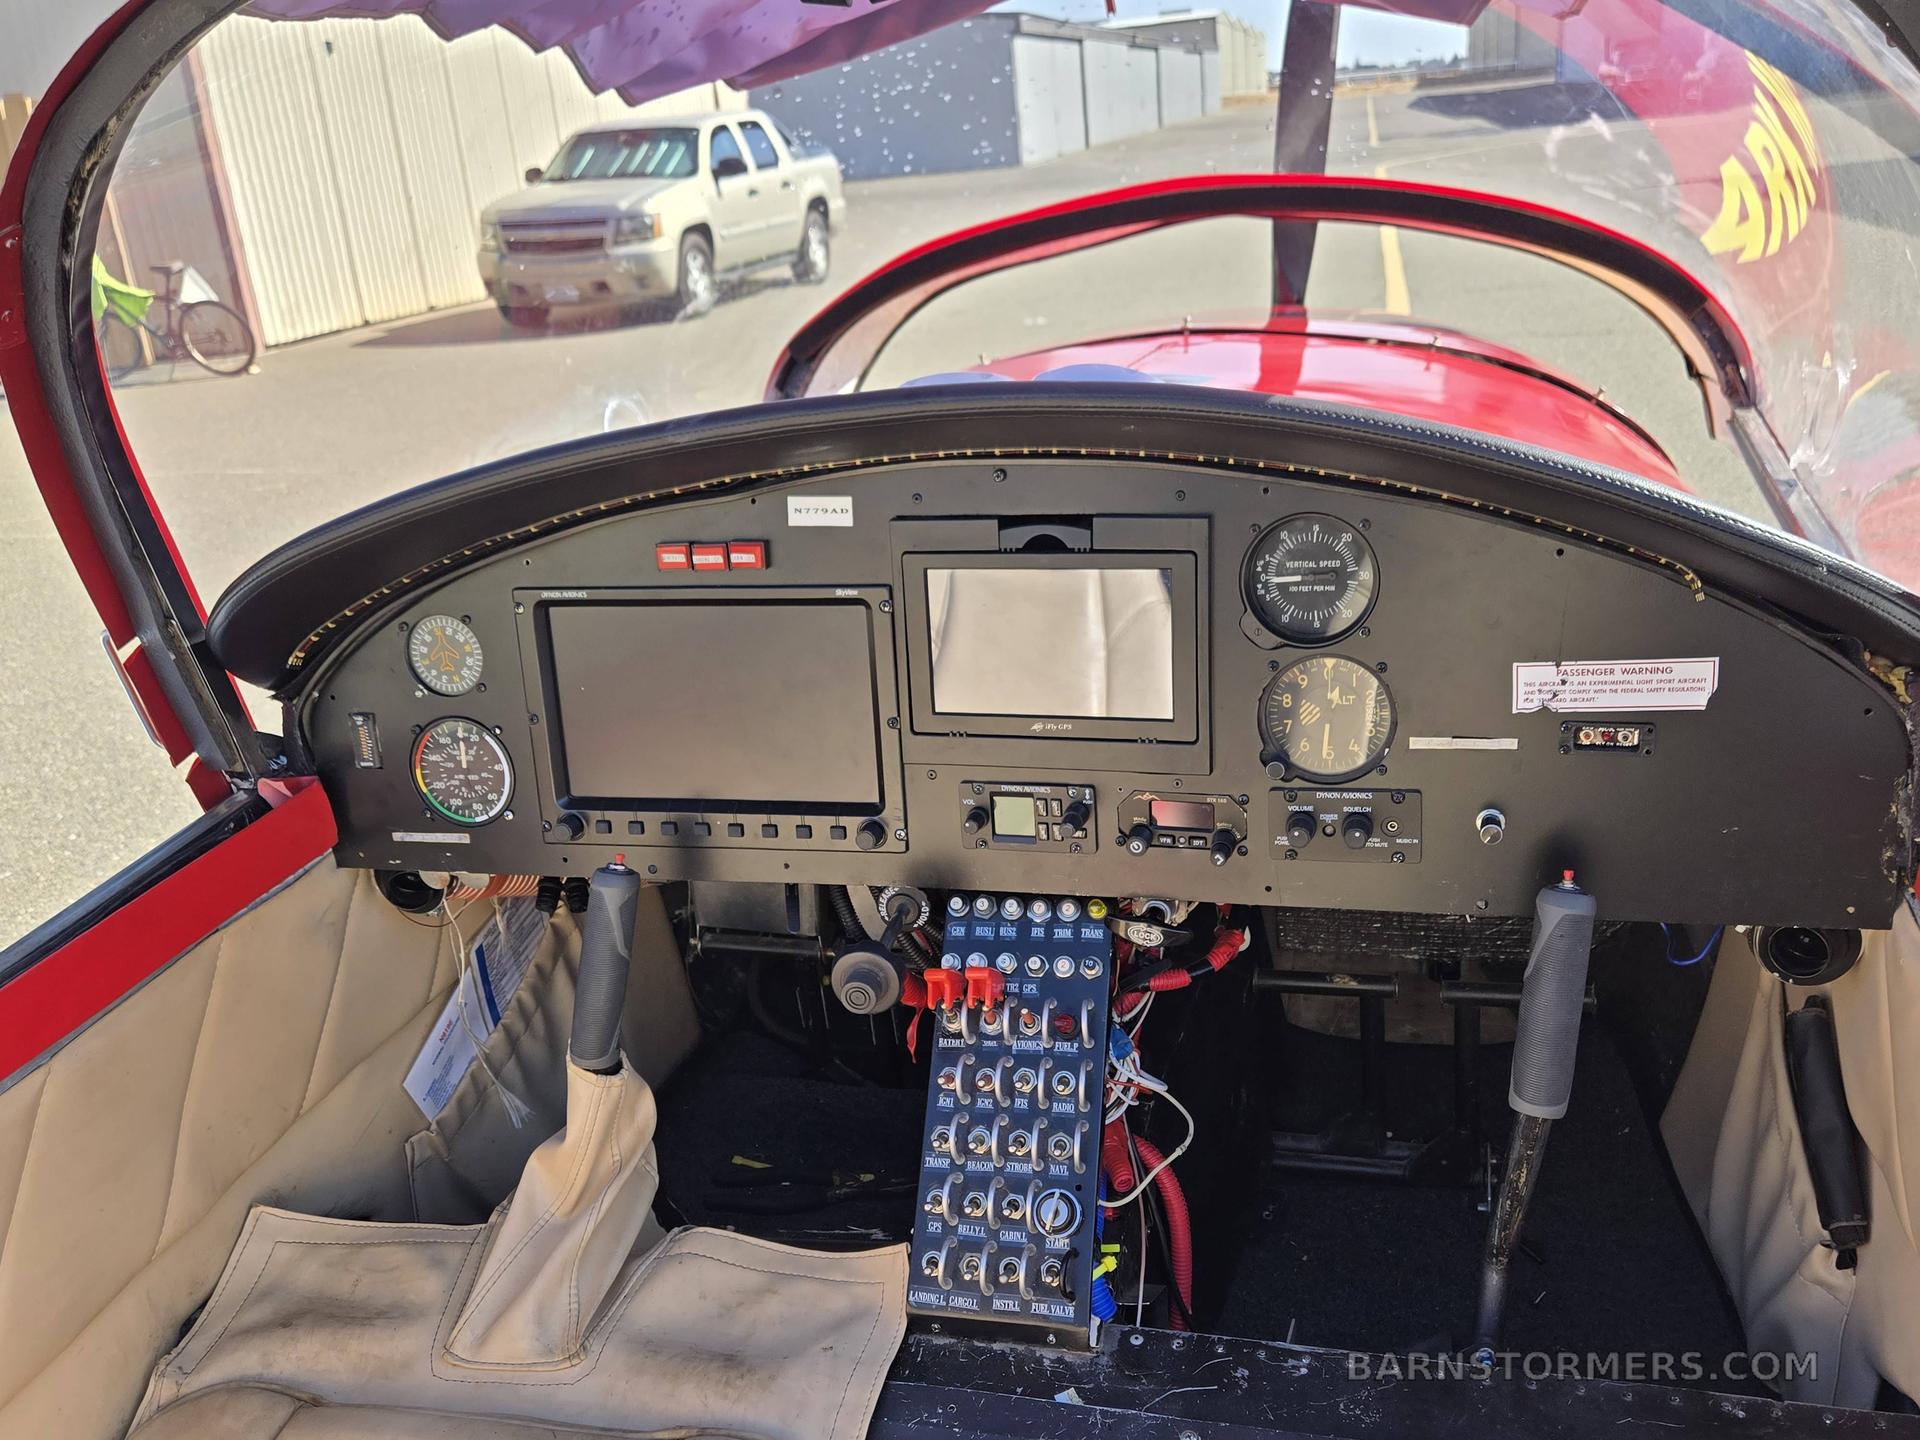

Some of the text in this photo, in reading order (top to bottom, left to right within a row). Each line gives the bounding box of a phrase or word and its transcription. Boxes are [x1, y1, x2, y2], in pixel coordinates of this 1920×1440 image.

[1280, 531, 1289, 539] 10
[1341, 533, 1353, 541] 20
[1285, 560, 1341, 569] VERTICAL SPEED
[1260, 574, 1266, 582] 0
[1358, 571, 1370, 580] 30
[1281, 614, 1289, 623] 10
[1341, 609, 1353, 618] 20
[1556, 666, 1673, 677] PASSENGER WARNING
[1298, 675, 1308, 688] 9
[1282, 693, 1292, 708] 8
[1366, 690, 1375, 704] 2
[1283, 720, 1292, 734] 7
[1300, 738, 1309, 752] 6
[1349, 739, 1360, 752] 4
[494, 763, 503, 771] 40
[1341, 792, 1373, 800] AVIONICS
[878, 887, 896, 918] RELEASE
[1065, 904, 1071, 912] 2
[917, 905, 930, 927] HOLD
[1053, 928, 1072, 938] TRIM
[1081, 928, 1104, 938] TRANS
[1085, 959, 1093, 967] 10
[1022, 983, 1037, 992] GPS
[1012, 1039, 1043, 1050] AVIONICS
[1052, 1102, 1075, 1112] RADIO
[924, 1157, 950, 1167] TRANSP
[966, 1161, 994, 1171] BEACON
[1005, 1162, 1032, 1172] STROBE
[927, 1222, 942, 1232] GPS
[1045, 1239, 1070, 1249] START
[1031, 1303, 1075, 1317] FUEL VALVE
